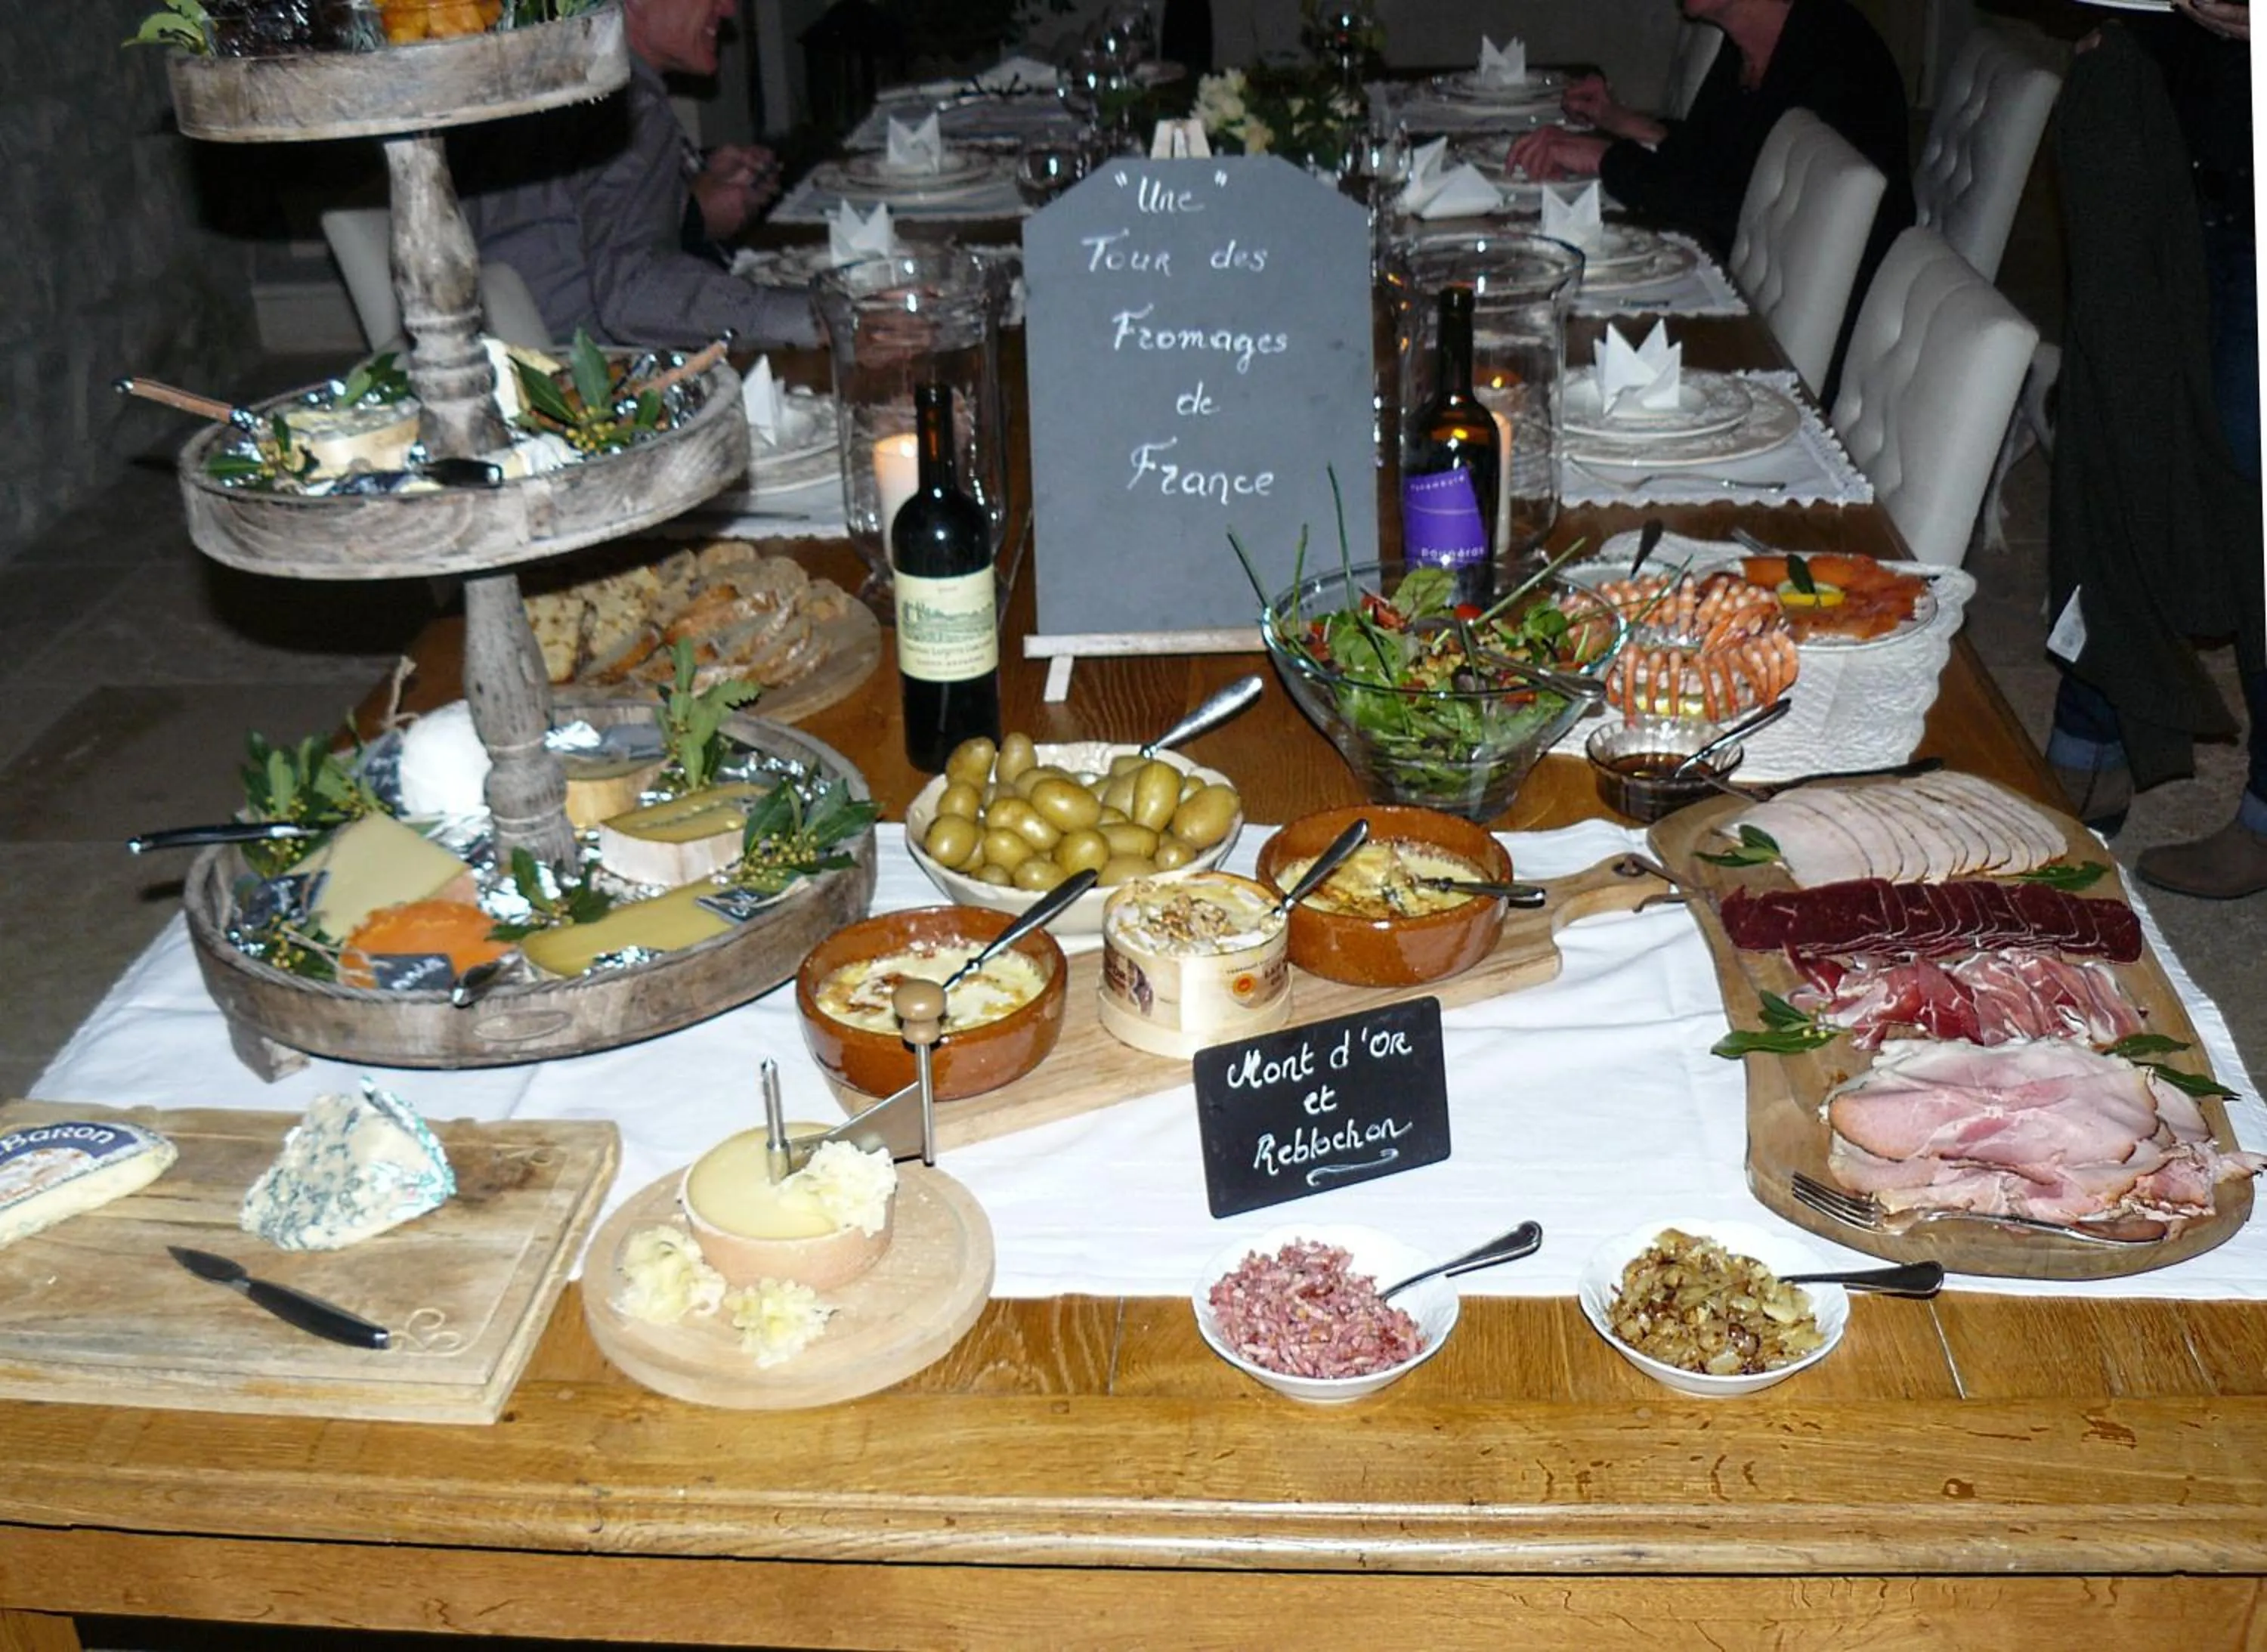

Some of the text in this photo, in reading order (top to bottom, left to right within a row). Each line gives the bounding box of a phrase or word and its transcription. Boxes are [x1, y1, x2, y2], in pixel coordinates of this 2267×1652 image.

[1209, 240, 1268, 272] des
[1112, 303, 1288, 374] Fromages
[1175, 381, 1221, 416] de
[1127, 437, 1275, 505] France
[1226, 1041, 1316, 1088] Mont
[1303, 1084, 1338, 1115] et
[1252, 1118, 1413, 1176] Reblochon
